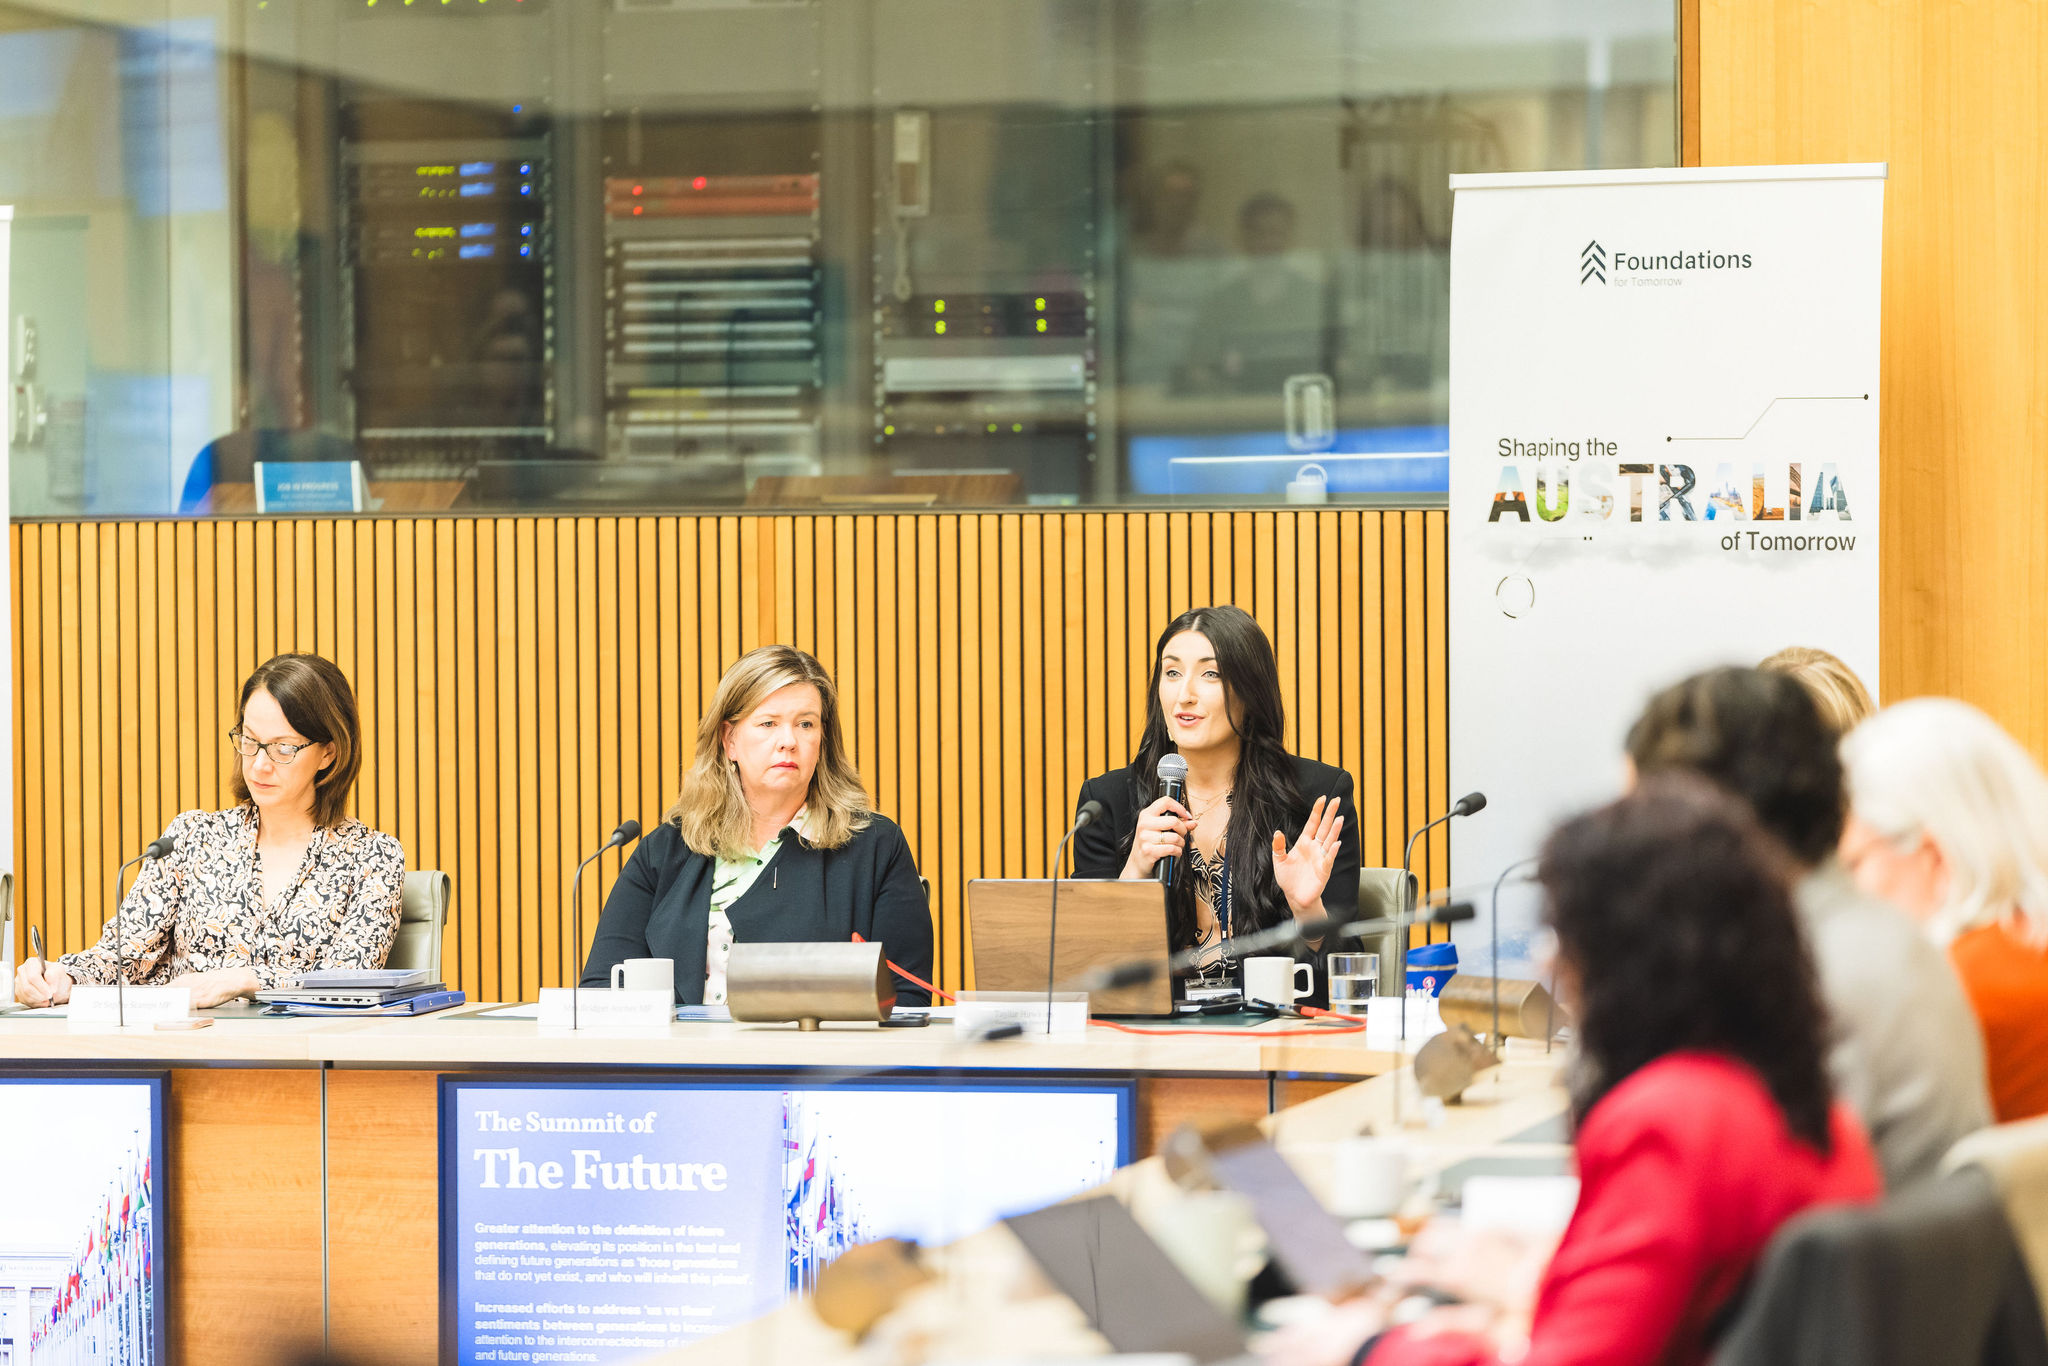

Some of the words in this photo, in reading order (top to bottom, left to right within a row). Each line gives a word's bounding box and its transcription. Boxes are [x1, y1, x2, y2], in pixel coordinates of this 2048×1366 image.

[1614, 249, 1752, 271] Foundations
[1614, 277, 1628, 287] for
[1631, 277, 1683, 287] Tomorrow
[1498, 438, 1580, 461] Shaping
[1586, 438, 1618, 457] the
[1487, 462, 1853, 523] AUSTRALIA
[1720, 531, 1741, 551] of
[1745, 531, 1856, 551] Tomorrow
[474, 1110, 522, 1131] The
[525, 1111, 625, 1134] Summit
[628, 1111, 657, 1134] of
[473, 1147, 564, 1190] The
[571, 1149, 728, 1192] Future
[474, 1222, 520, 1234] Greater
[521, 1223, 575, 1235] attention
[577, 1223, 590, 1235] to
[592, 1224, 612, 1235] the
[613, 1224, 671, 1236] definition
[673, 1225, 687, 1236] of
[474, 1239, 549, 1252] generations,
[550, 1240, 601, 1254] elevating
[602, 1241, 616, 1252] its
[617, 1241, 662, 1255] position
[663, 1242, 674, 1253] in
[675, 1242, 694, 1253] the
[474, 1254, 519, 1268] defining
[520, 1255, 552, 1266] future
[554, 1256, 619, 1269] generations
[620, 1258, 635, 1267] as
[474, 1270, 496, 1281] that
[498, 1270, 513, 1281] do
[514, 1271, 533, 1281] not
[534, 1271, 552, 1284] yet
[553, 1271, 584, 1283] exist,
[585, 1271, 607, 1283] and
[608, 1272, 632, 1283] who
[634, 1272, 653, 1283] will
[474, 1302, 534, 1313] Increased
[535, 1302, 575, 1314] efforts
[577, 1303, 590, 1314] to
[592, 1304, 641, 1315] address
[474, 1319, 541, 1331] sentiments
[542, 1319, 594, 1331] between
[596, 1321, 668, 1334] generations
[669, 1321, 682, 1333] to
[474, 1334, 523, 1345] attention
[524, 1335, 535, 1345] to
[537, 1335, 555, 1346] the
[557, 1335, 666, 1348] interconnectedness
[474, 1350, 497, 1361] and
[498, 1350, 530, 1361] future
[532, 1351, 600, 1364] generations.
